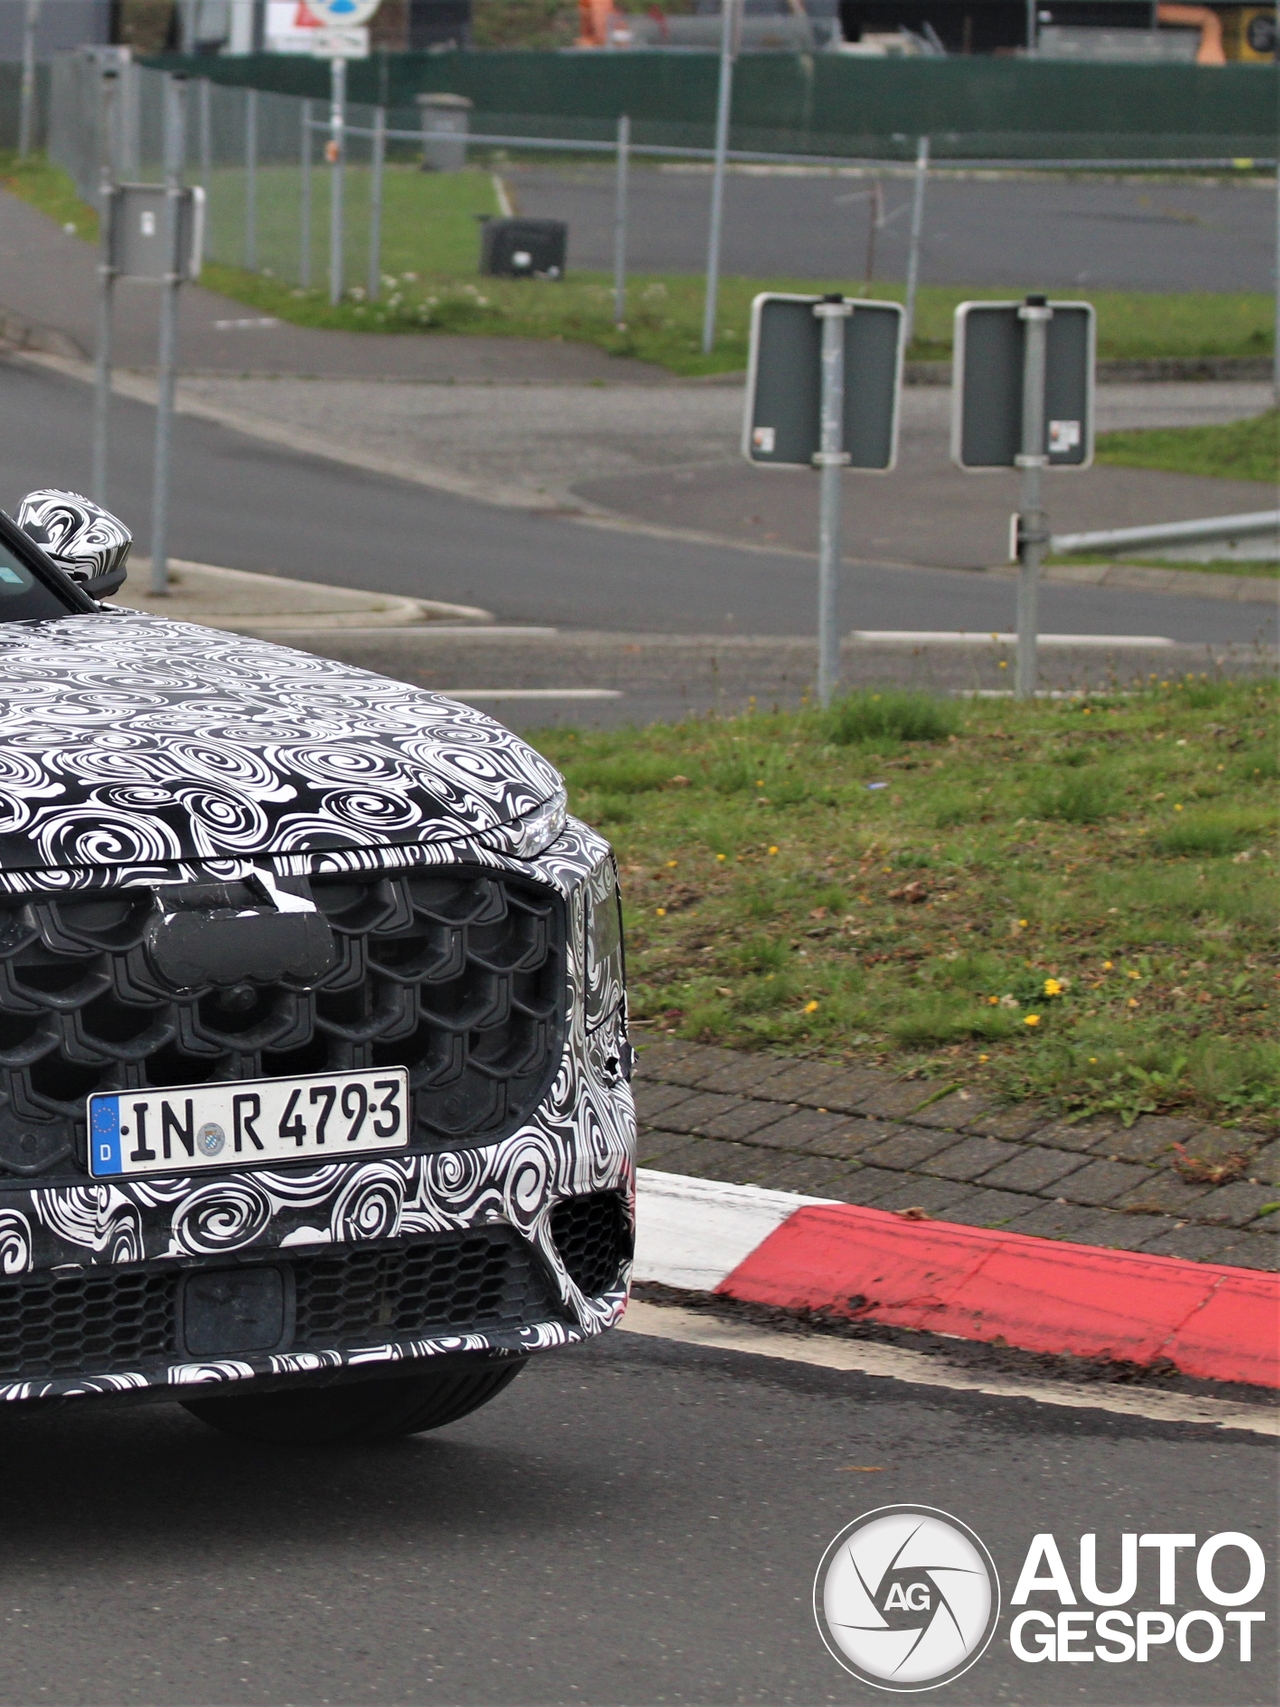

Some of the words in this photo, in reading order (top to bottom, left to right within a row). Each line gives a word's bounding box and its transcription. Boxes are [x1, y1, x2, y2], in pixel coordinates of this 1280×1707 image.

[130, 1098, 195, 1162] IN
[233, 1093, 265, 1152] R
[278, 1079, 401, 1146] 4793
[100, 1144, 112, 1162] D
